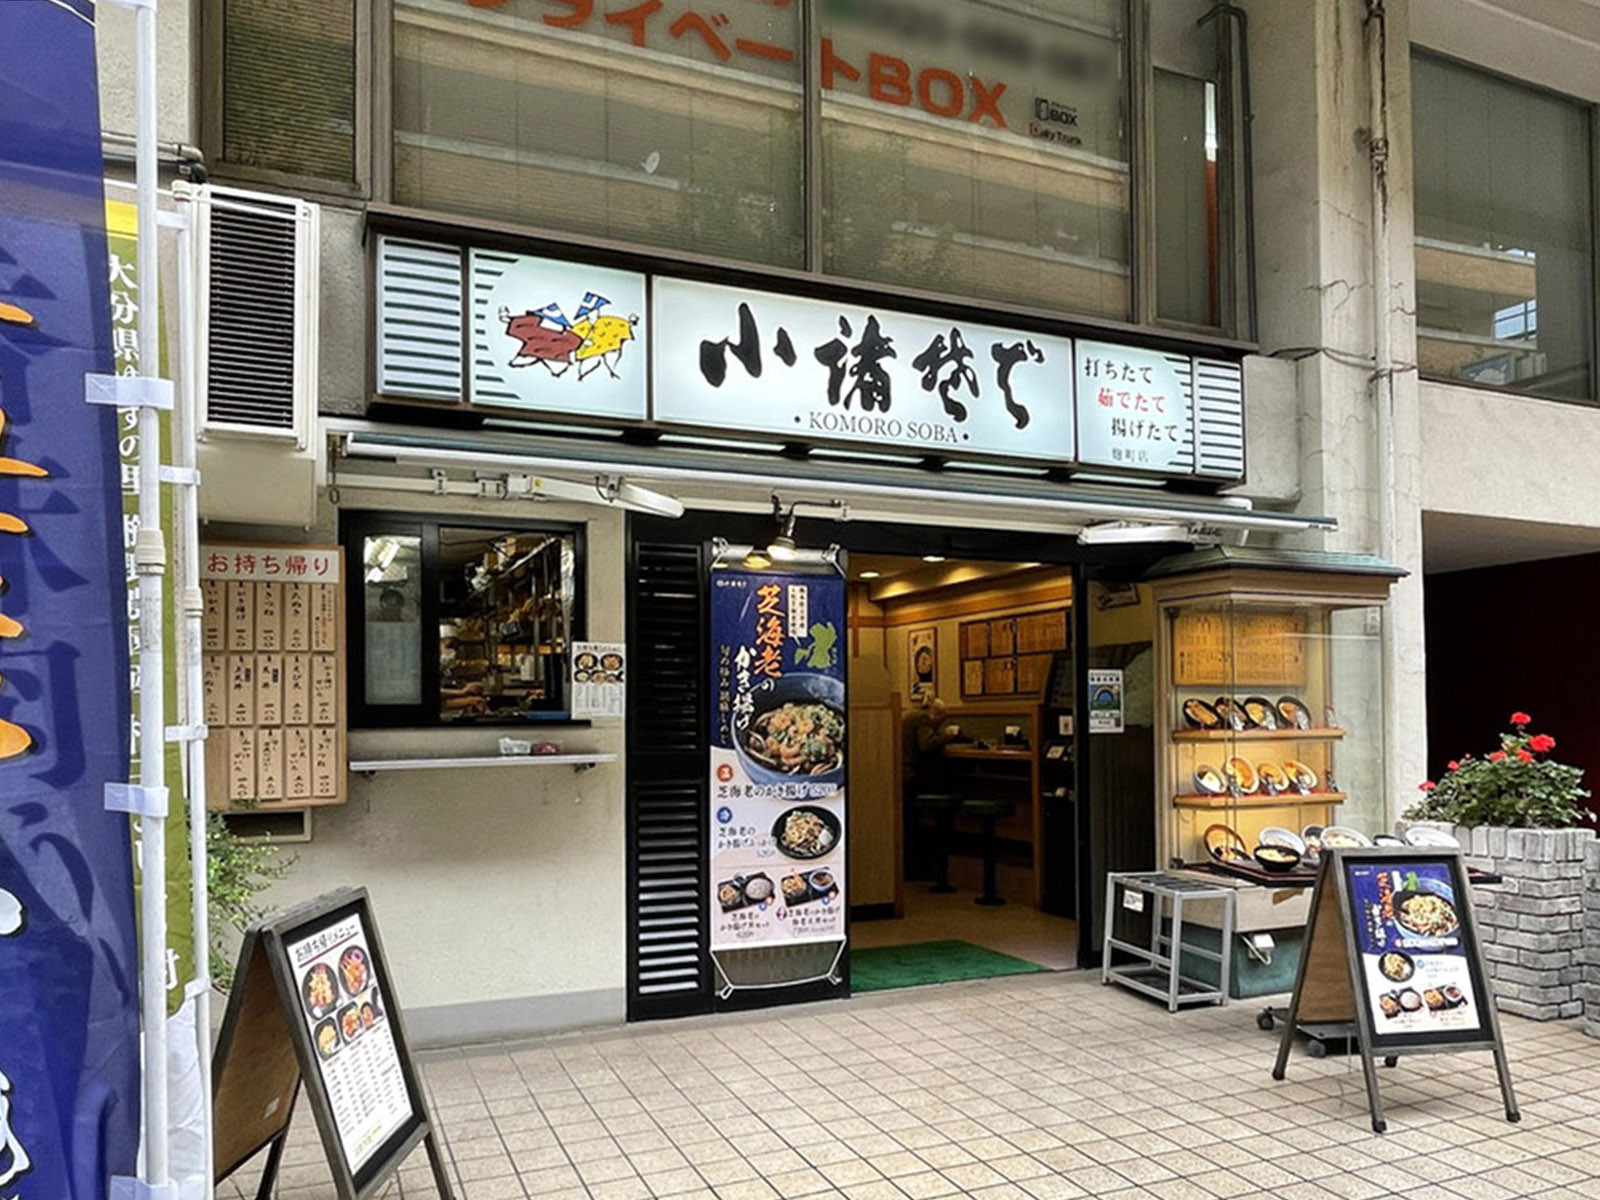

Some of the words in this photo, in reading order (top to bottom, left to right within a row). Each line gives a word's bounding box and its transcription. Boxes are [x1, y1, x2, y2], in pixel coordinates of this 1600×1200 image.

[1085, 356, 1153, 383] 打ちたて
[1098, 387, 1165, 413] 茹でたて
[809, 411, 903, 439] KOMORO
[906, 422, 958, 444] SOBA
[1111, 416, 1178, 442] 揚げたて
[207, 553, 329, 576] お持ち帰り
